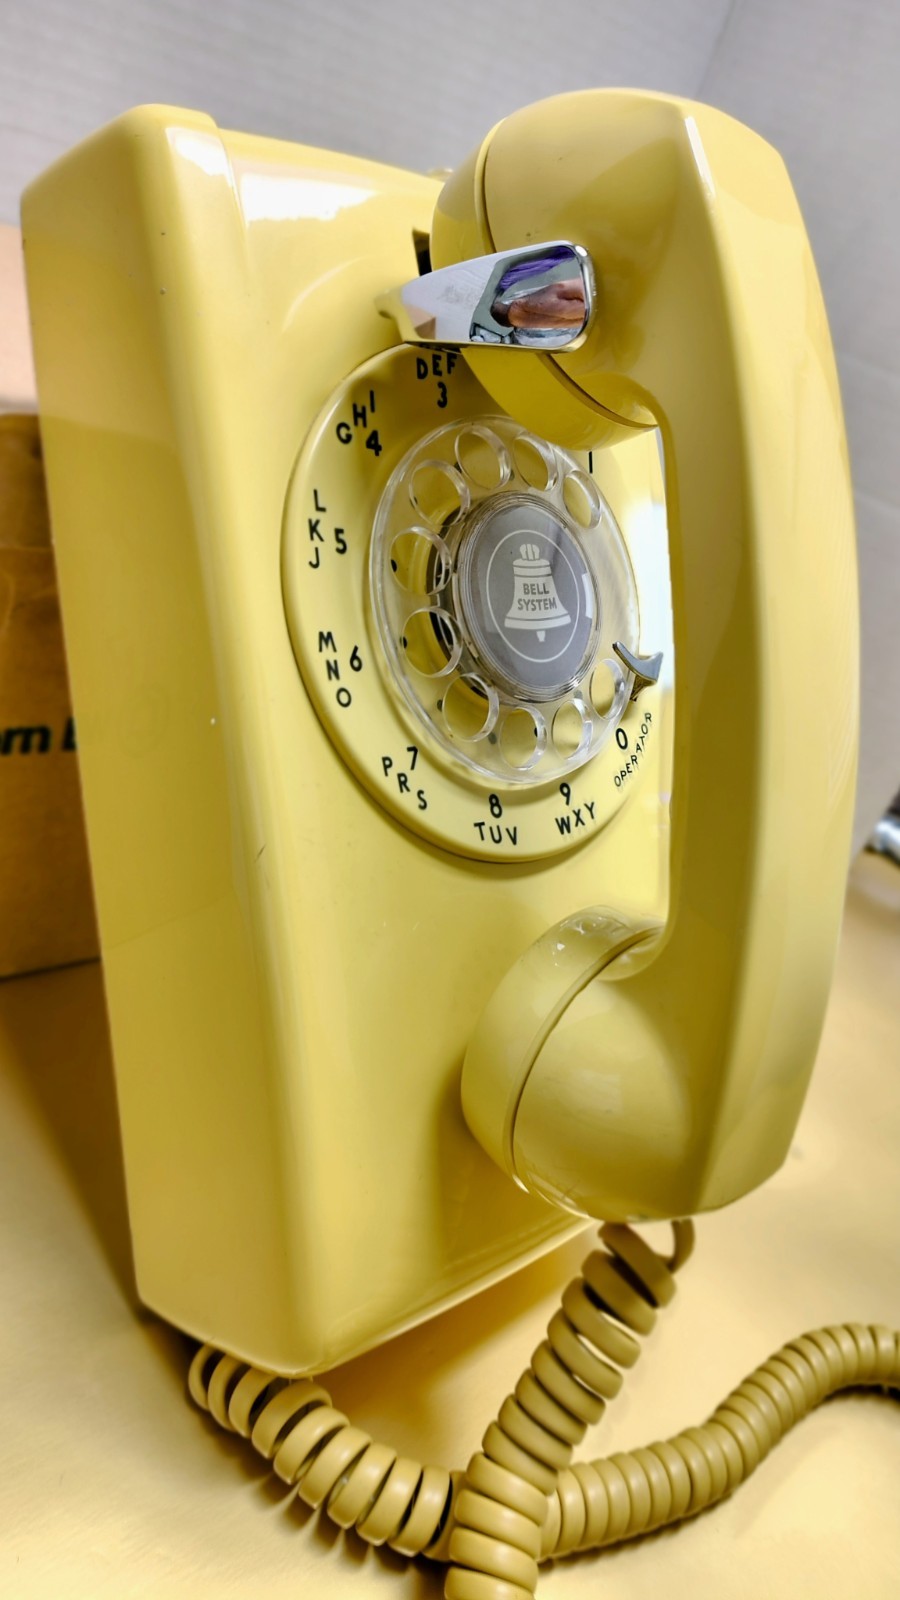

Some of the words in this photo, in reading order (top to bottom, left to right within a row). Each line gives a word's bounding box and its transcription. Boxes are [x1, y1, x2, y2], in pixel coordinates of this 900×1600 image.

[415, 352, 458, 380] DEF
[436, 381, 448, 408] 3
[336, 389, 376, 444] GHI
[365, 429, 382, 457] 4
[334, 527, 348, 555] 5
[522, 582, 550, 595] BELL
[517, 597, 557, 611] SYSTEM
[349, 645, 363, 672] 6
[406, 746, 419, 771] 7
[614, 712, 652, 787] OPERATOR
[381, 755, 428, 811] PRS
[558, 781, 571, 806] 9
[488, 793, 503, 819] 8
[554, 802, 596, 836] WXY
[473, 821, 518, 846] TUV
